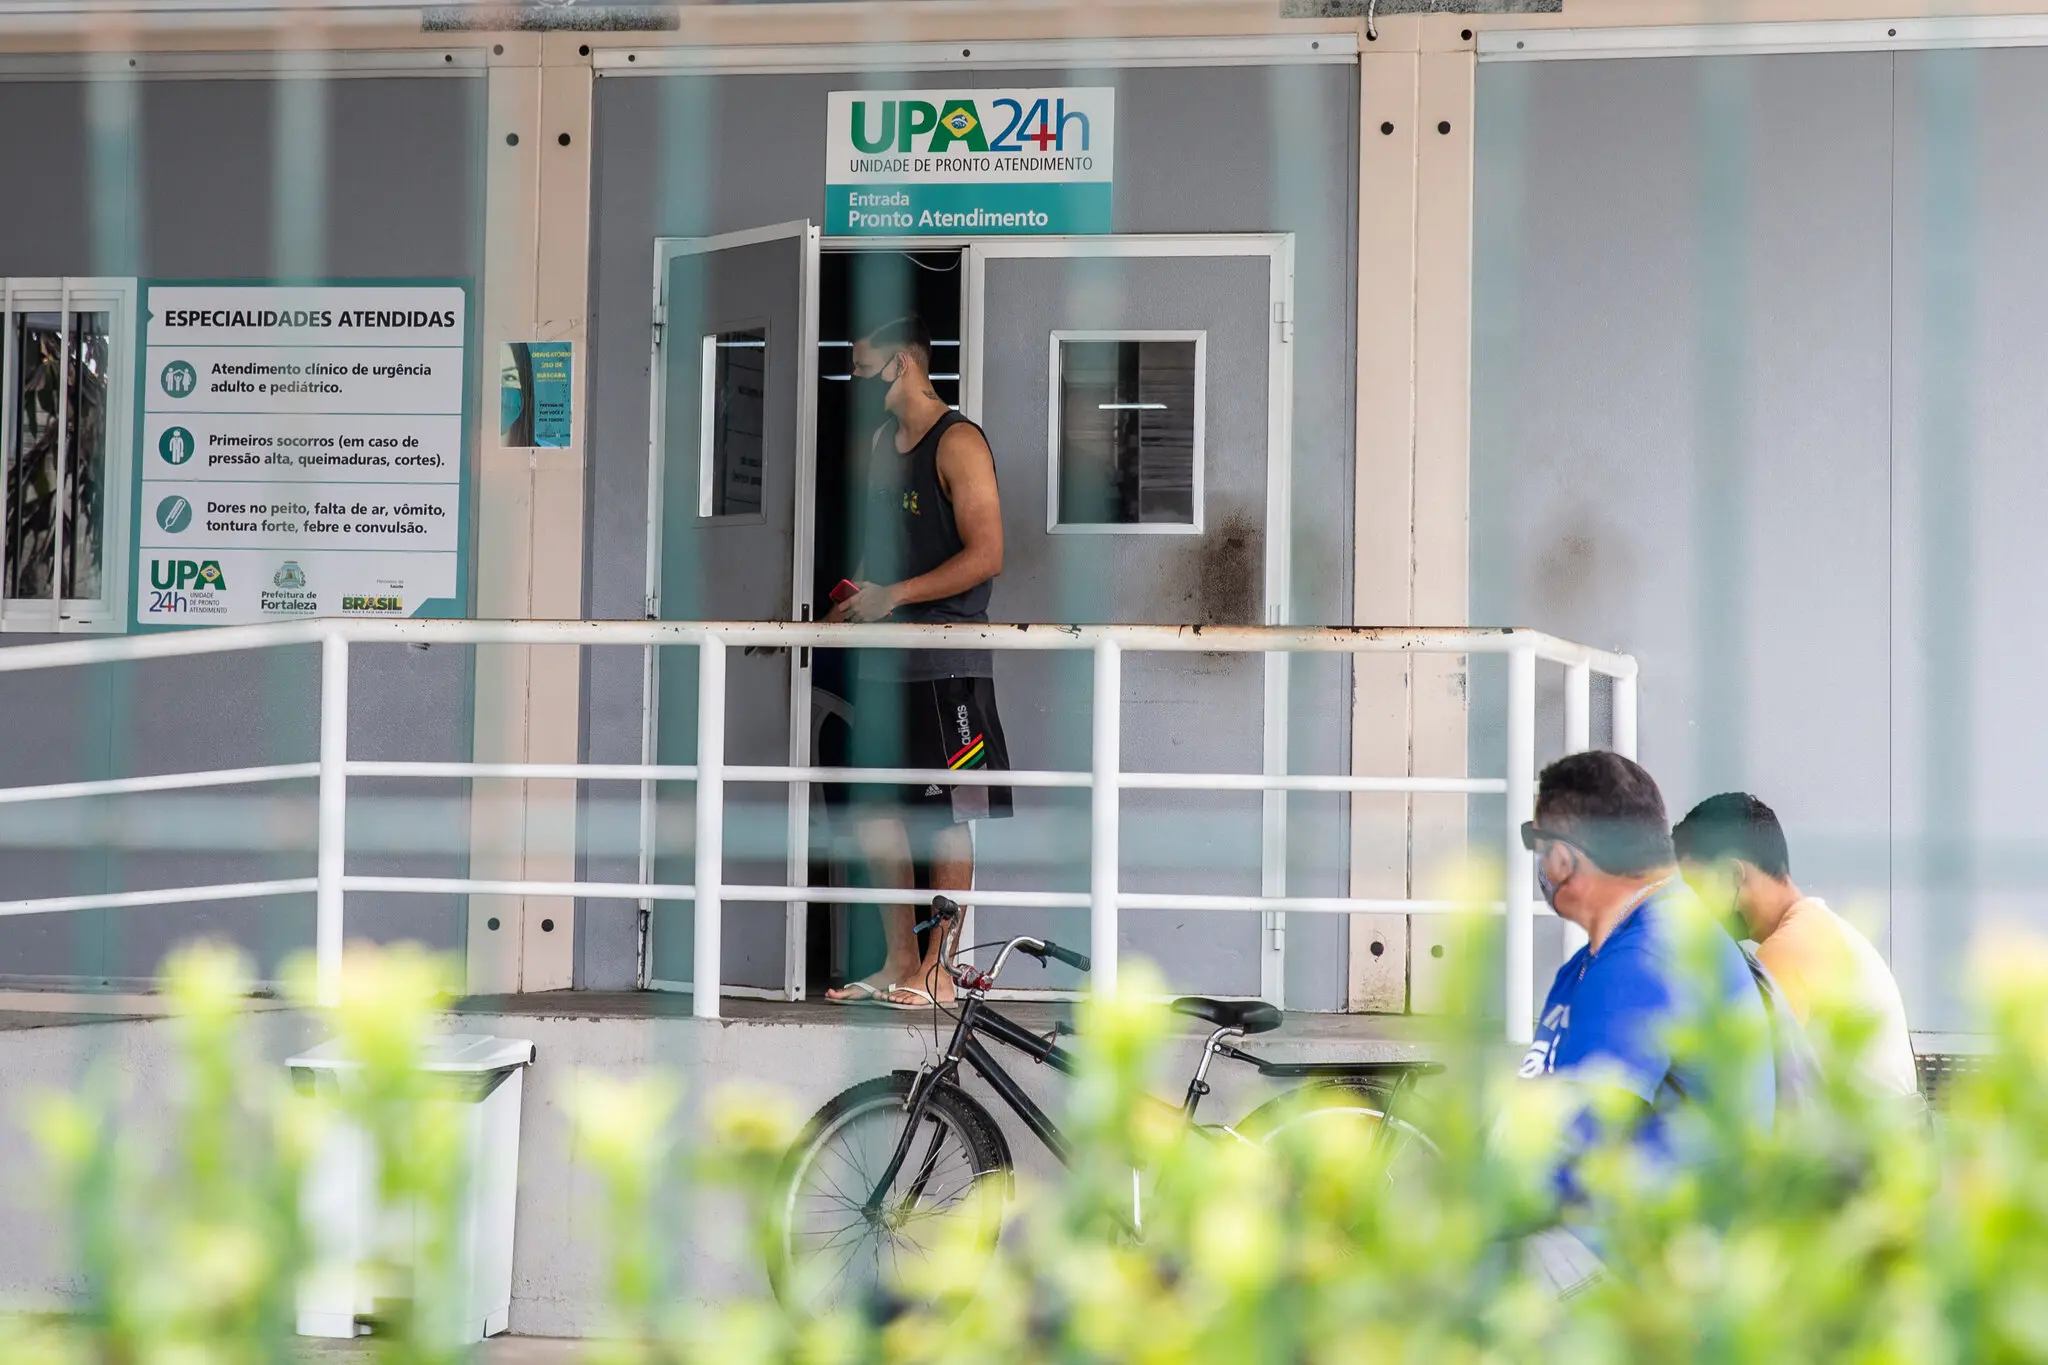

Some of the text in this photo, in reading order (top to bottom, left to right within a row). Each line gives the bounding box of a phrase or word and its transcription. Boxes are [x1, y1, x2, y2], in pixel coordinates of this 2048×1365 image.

[850, 157, 1093, 172] UNIDADE DE PRONTO ATENDIMENTO
[849, 192, 910, 207] Entrada
[849, 209, 1049, 228] Pronto Atendimento
[165, 310, 455, 328] ESPECIALIDADES ATENDIDAS
[211, 363, 432, 379] Atendimento clínico de urgência
[211, 381, 343, 396] adulto e pediátrico.
[209, 434, 419, 450] Primeiros socorros (em caso de
[208, 453, 445, 469] pressão alta, queimaduras, cortes).
[207, 502, 446, 519] Dores no peito, falta de ar, vômito,
[207, 520, 427, 535] tontura forte, febre e convulsão.
[151, 560, 227, 590] UPA
[149, 592, 187, 613] 24h
[261, 591, 304, 599] Prefeitura
[261, 600, 317, 610] Fortaleza
[343, 597, 402, 610] BRASIL
[956, 704, 971, 746] adidas
